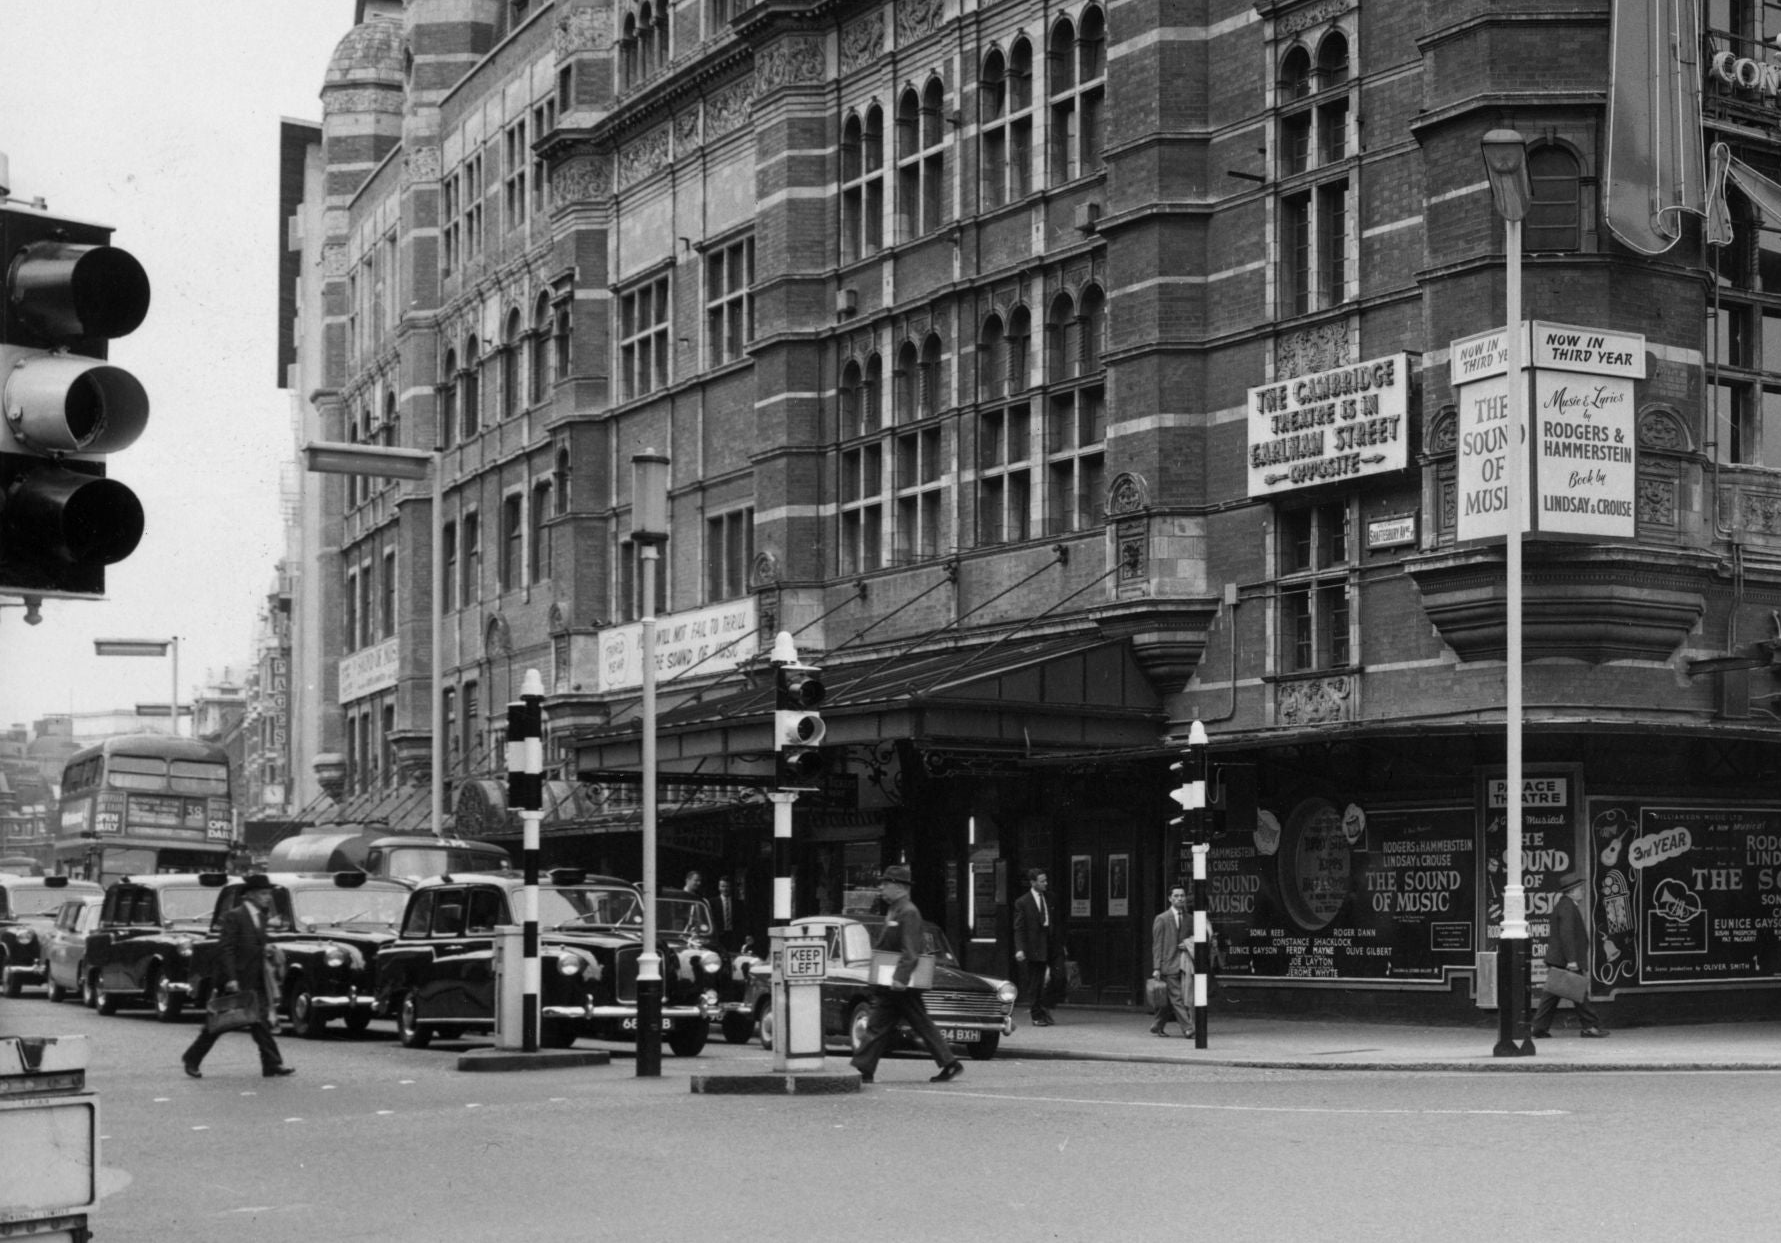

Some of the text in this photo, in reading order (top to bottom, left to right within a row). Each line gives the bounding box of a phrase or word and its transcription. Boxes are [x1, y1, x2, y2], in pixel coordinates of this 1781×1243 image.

[1546, 333, 1605, 350] NOW IN
[1552, 347, 1633, 366] THIRD YEAR
[1254, 359, 1395, 415] THE CAMBRIDGE
[1543, 386, 1582, 415] Music
[1591, 385, 1625, 410] Lyrics
[1270, 394, 1379, 436] THEATRE IS IN
[1583, 409, 1592, 423] by
[1250, 414, 1400, 469] EARLHAM STREET
[1543, 420, 1625, 444] RODGERS &
[1543, 440, 1632, 464] HAMMERSTEIN
[1288, 452, 1361, 484] OPPOSITE
[1568, 468, 1607, 489] Book by
[1543, 494, 1632, 518] LINDSAY & CROUSE
[691, 620, 707, 640] FAIL
[710, 618, 719, 635] TO
[722, 612, 746, 634] THRILL
[667, 648, 693, 670] SOUND
[698, 644, 709, 659] OF
[1653, 832, 1687, 858] YEAR
[1692, 868, 1743, 891] THE
[790, 949, 821, 961] KEEP
[790, 962, 820, 974] LEFT
[956, 1029, 979, 1041] BXH
